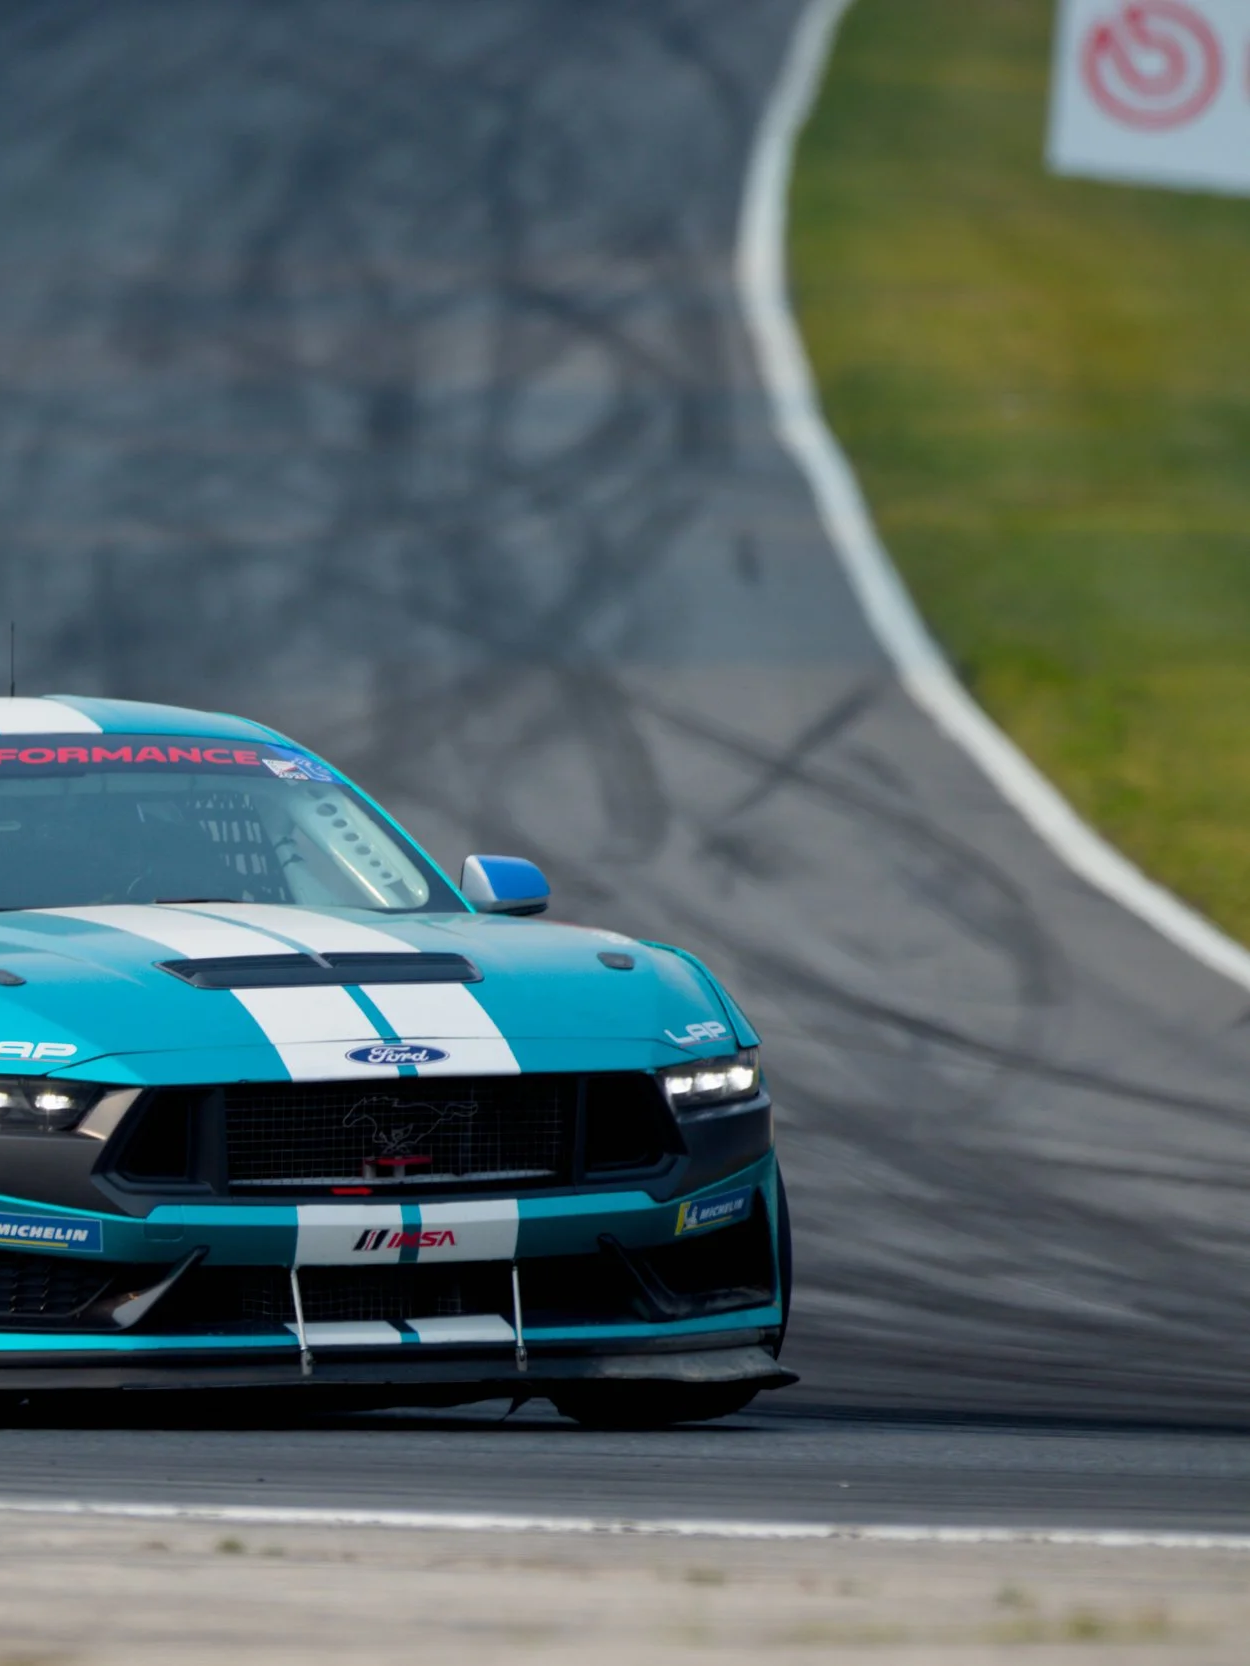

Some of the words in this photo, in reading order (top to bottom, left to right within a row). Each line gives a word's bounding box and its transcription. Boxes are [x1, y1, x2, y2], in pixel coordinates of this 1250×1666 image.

[663, 1020, 727, 1044] LAP
[367, 1045, 430, 1063] Ford
[699, 1197, 745, 1221] MICHELIN
[386, 1230, 456, 1249] IMSA
